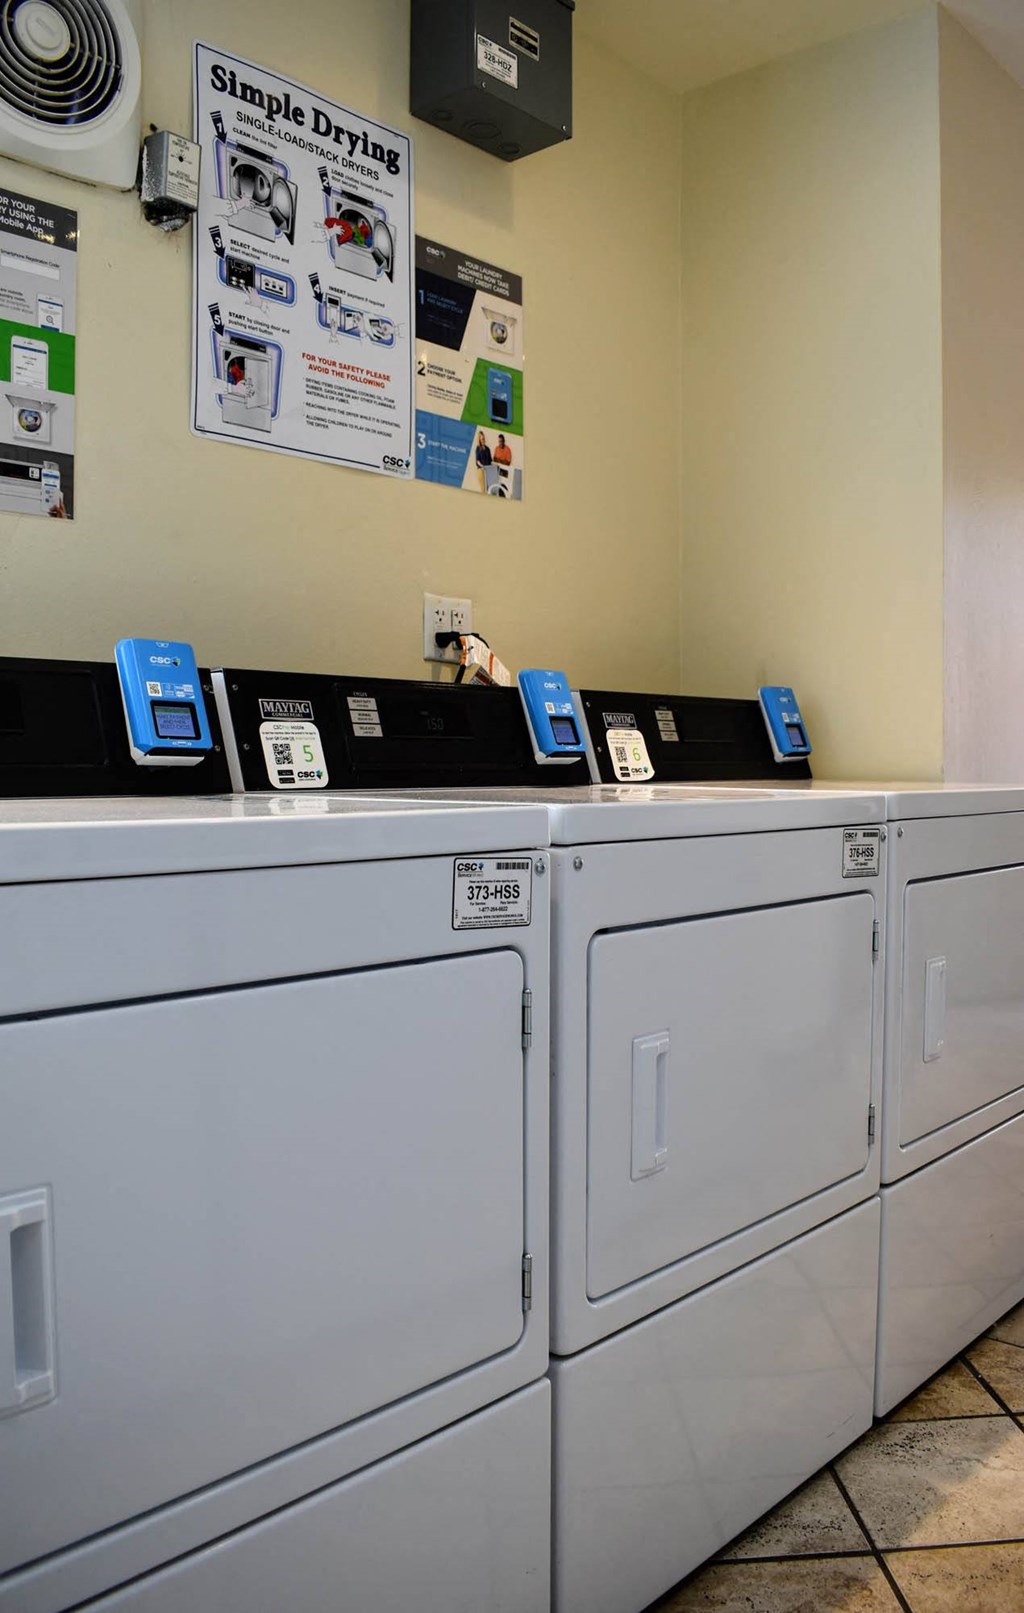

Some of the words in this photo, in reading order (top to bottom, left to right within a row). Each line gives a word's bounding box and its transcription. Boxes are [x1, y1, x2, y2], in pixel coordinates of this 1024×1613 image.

[210, 64, 305, 126] Simple
[311, 107, 401, 175] Drying
[216, 123, 223, 132] 1
[232, 127, 251, 139] CLEAN
[236, 110, 339, 164] SINGLE-LOAD/STACK
[341, 157, 380, 182] DRYERS
[331, 168, 344, 178] LOAD
[322, 177, 329, 187] 2
[10, 199, 36, 213] YOUR
[9, 208, 36, 223] USING
[37, 216, 54, 229] THE
[26, 223, 44, 237] App
[214, 239, 222, 249] 3
[230, 238, 251, 250] SELECT
[269, 252, 281, 261] cycle
[464, 260, 479, 270] YOUR
[484, 274, 496, 284] NOW
[497, 278, 510, 289] TAKE
[313, 284, 320, 293] 4
[329, 285, 347, 296] INSERT
[493, 285, 510, 297] CARDS
[419, 289, 424, 305] 1
[214, 314, 221, 326] 5
[228, 311, 246, 321] START
[302, 352, 316, 362] FOR
[318, 356, 337, 368] YOUR
[338, 361, 364, 375] SAFETY
[365, 368, 391, 382] PLEASE
[417, 361, 426, 377] 2
[307, 363, 330, 376] AVOID
[331, 369, 345, 379] THE
[346, 373, 386, 389] FOLLOWING
[417, 433, 426, 449] 3
[382, 455, 404, 468] CSC
[149, 655, 171, 664] CSC
[263, 701, 310, 714] MAYTAG
[606, 714, 634, 724] MAYTAG
[303, 745, 314, 763] 5
[632, 747, 641, 761] 6
[297, 770, 315, 779] CSC
[849, 847, 874, 858] 376-HSS
[457, 863, 478, 872] CSC
[467, 884, 520, 900] 373-HSS
